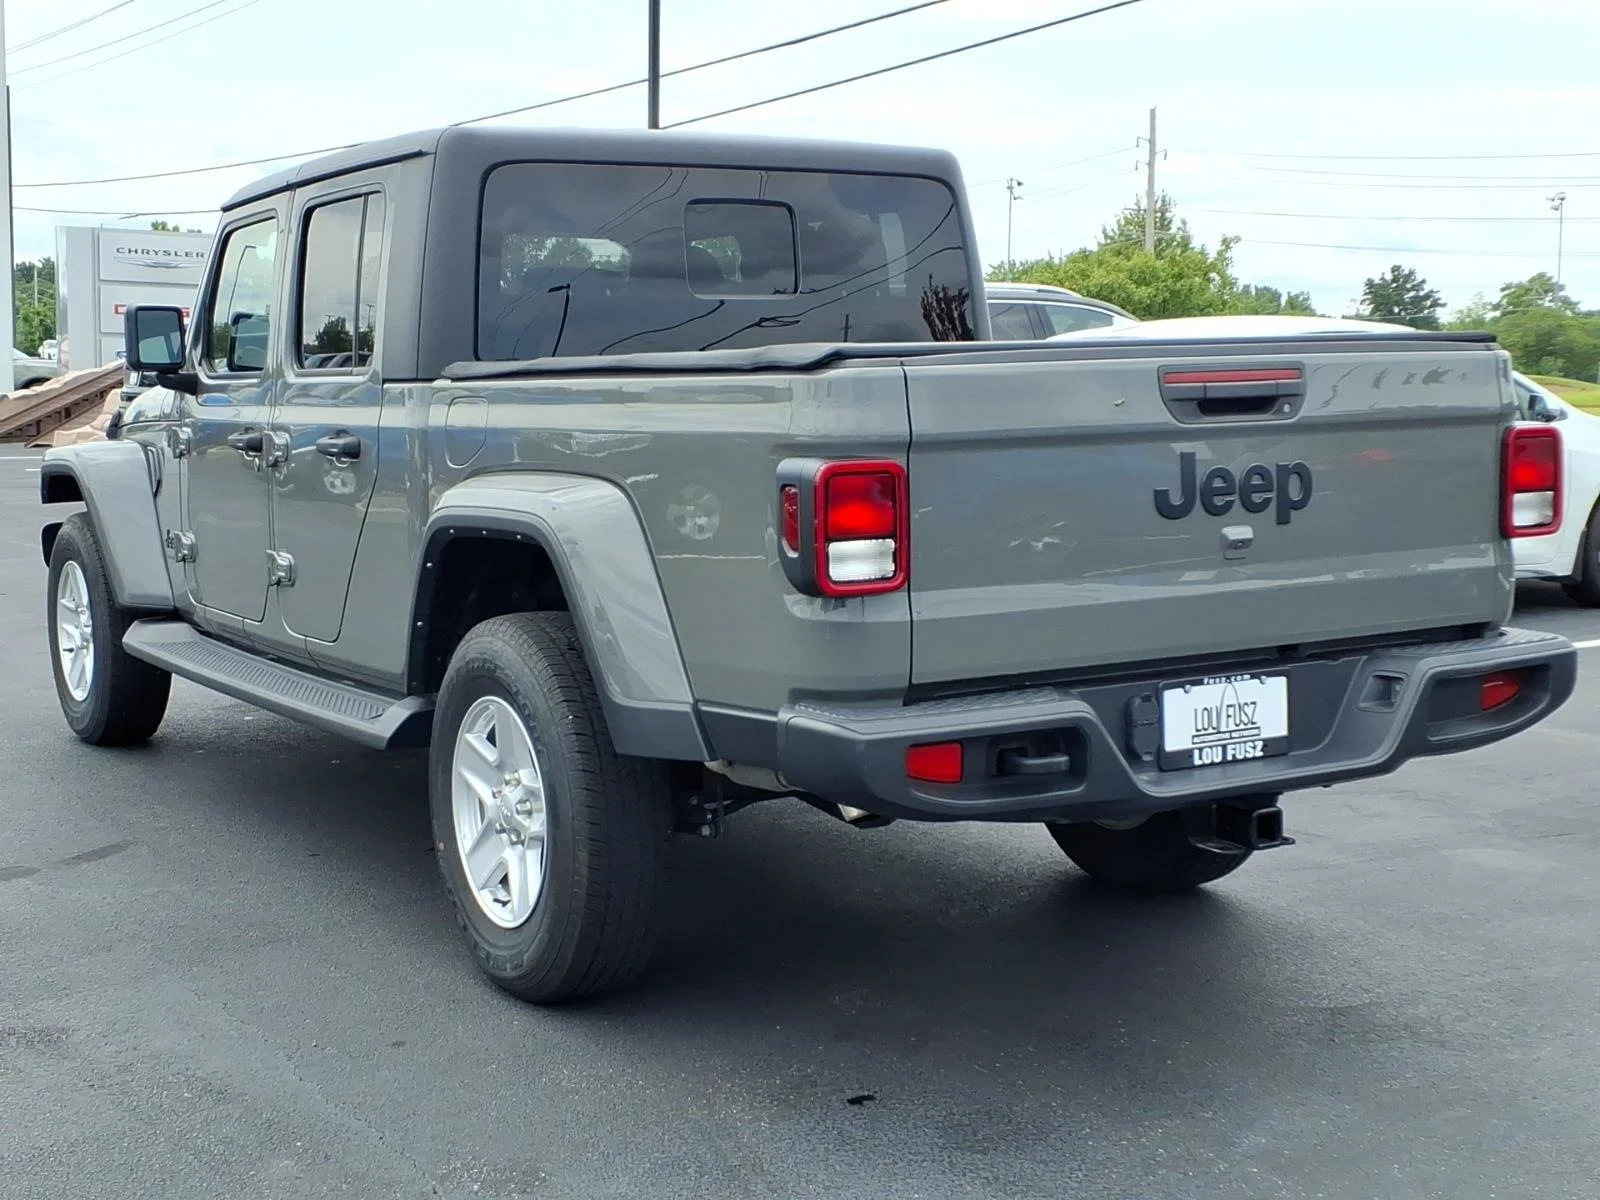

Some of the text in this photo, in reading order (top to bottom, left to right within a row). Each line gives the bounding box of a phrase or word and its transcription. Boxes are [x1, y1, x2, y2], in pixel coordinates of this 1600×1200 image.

[115, 247, 205, 258] CHRYSLER
[1153, 451, 1313, 526] Jeep
[1203, 674, 1251, 685] fusz.com
[1194, 701, 1257, 732] LOU FUSZ
[1193, 740, 1264, 765] LOU FUSZ
